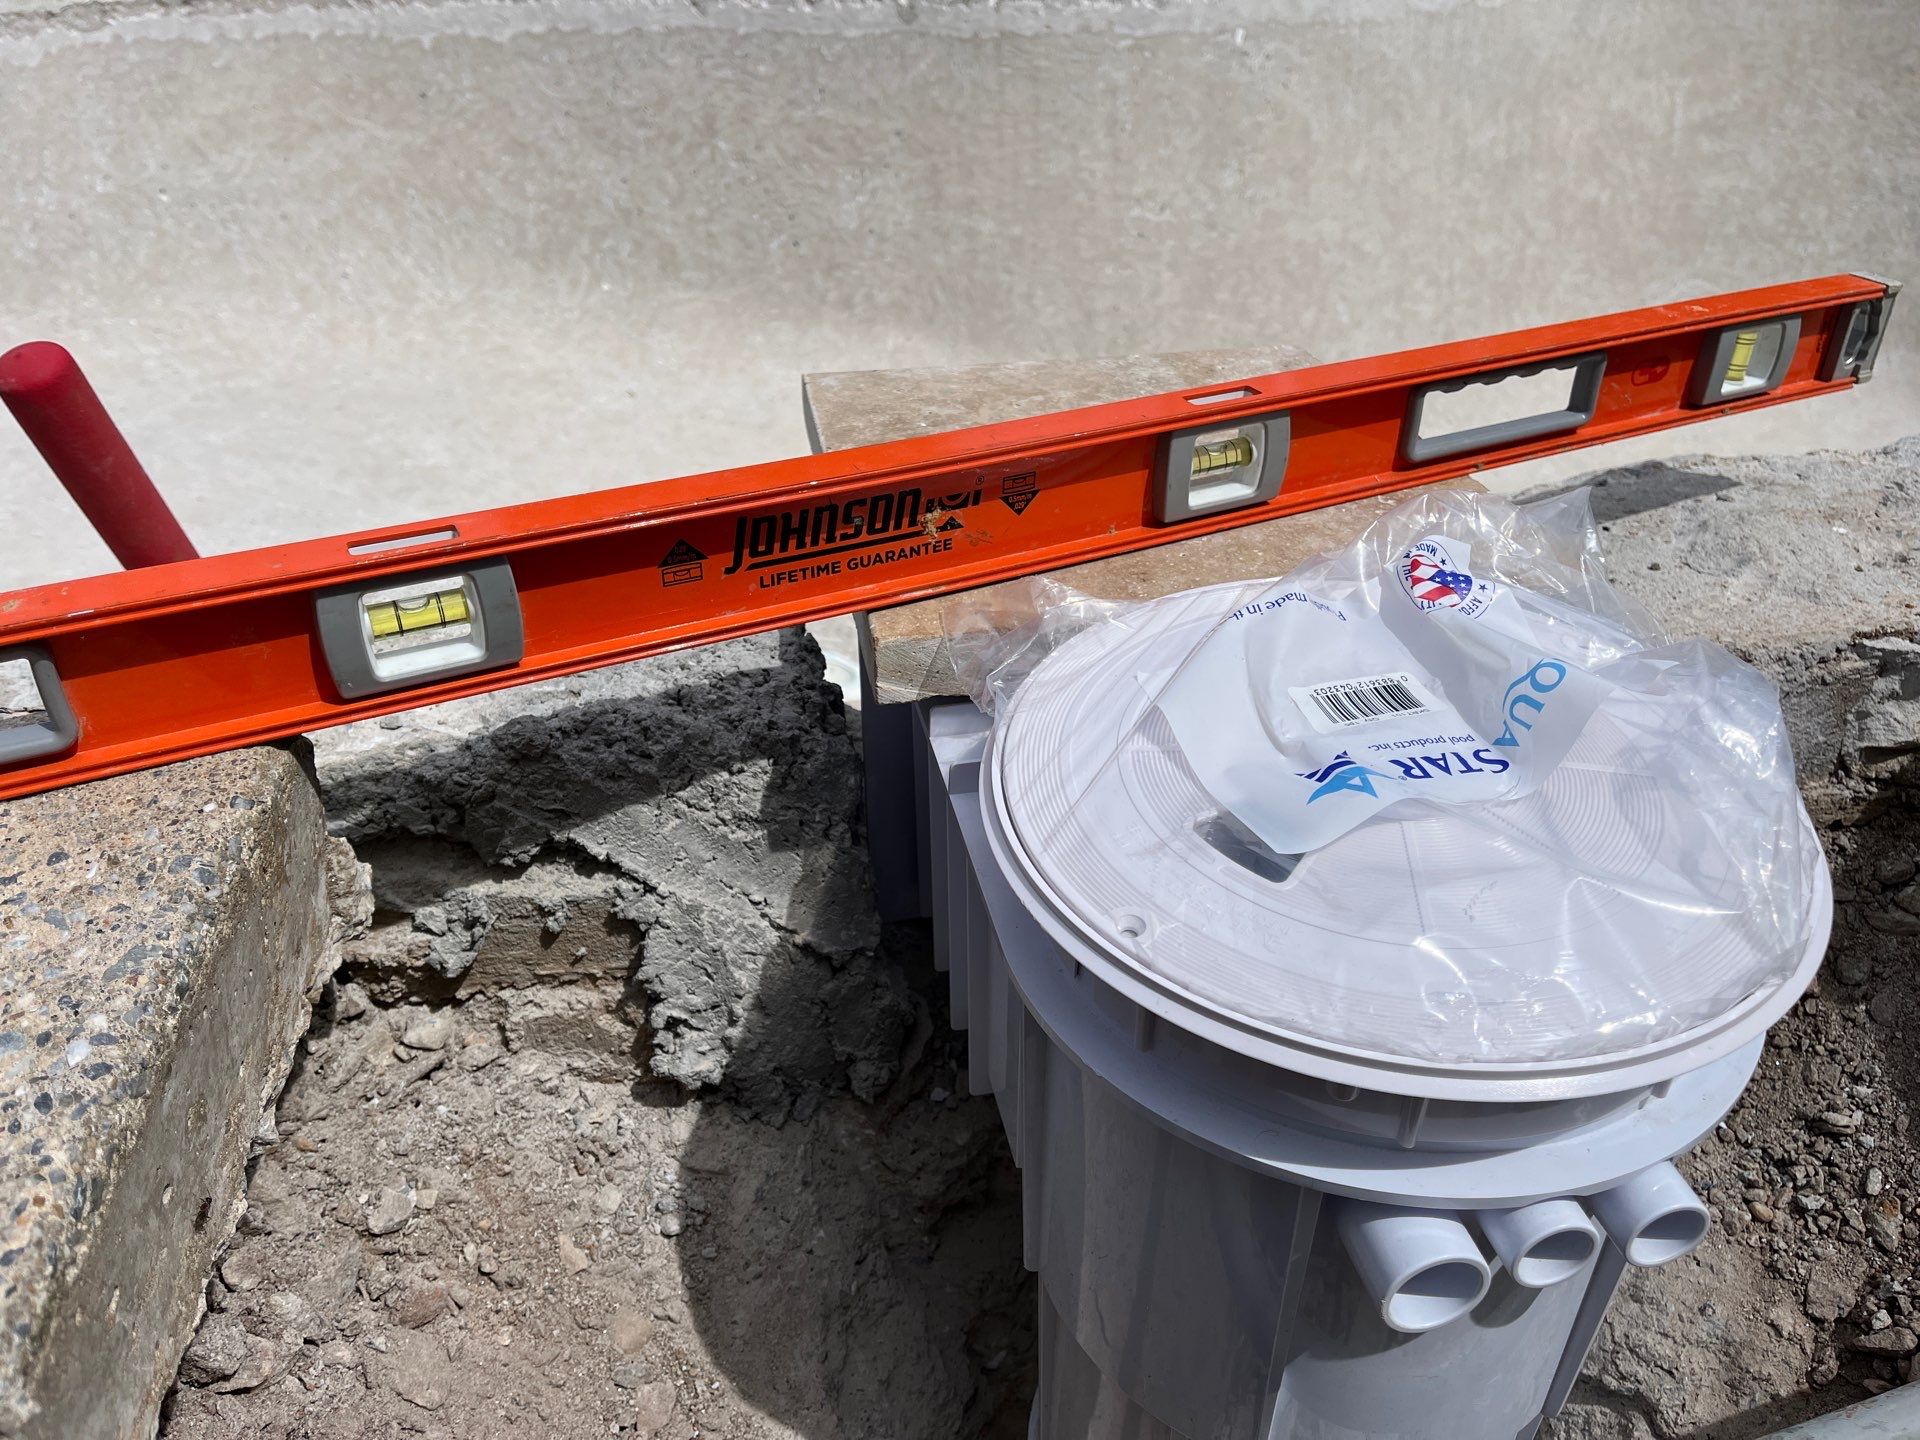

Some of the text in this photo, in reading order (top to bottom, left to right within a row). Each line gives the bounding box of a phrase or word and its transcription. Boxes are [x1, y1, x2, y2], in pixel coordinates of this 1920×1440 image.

[722, 487, 922, 576] JOHNSON
[1415, 543, 1438, 557] MADE
[759, 538, 953, 589] LIFETIME GUARANTEE
[1246, 603, 1264, 615] in
[1458, 595, 1483, 616] AFFO
[1313, 683, 1353, 696] 043203
[1367, 733, 1476, 753] pool products inc.
